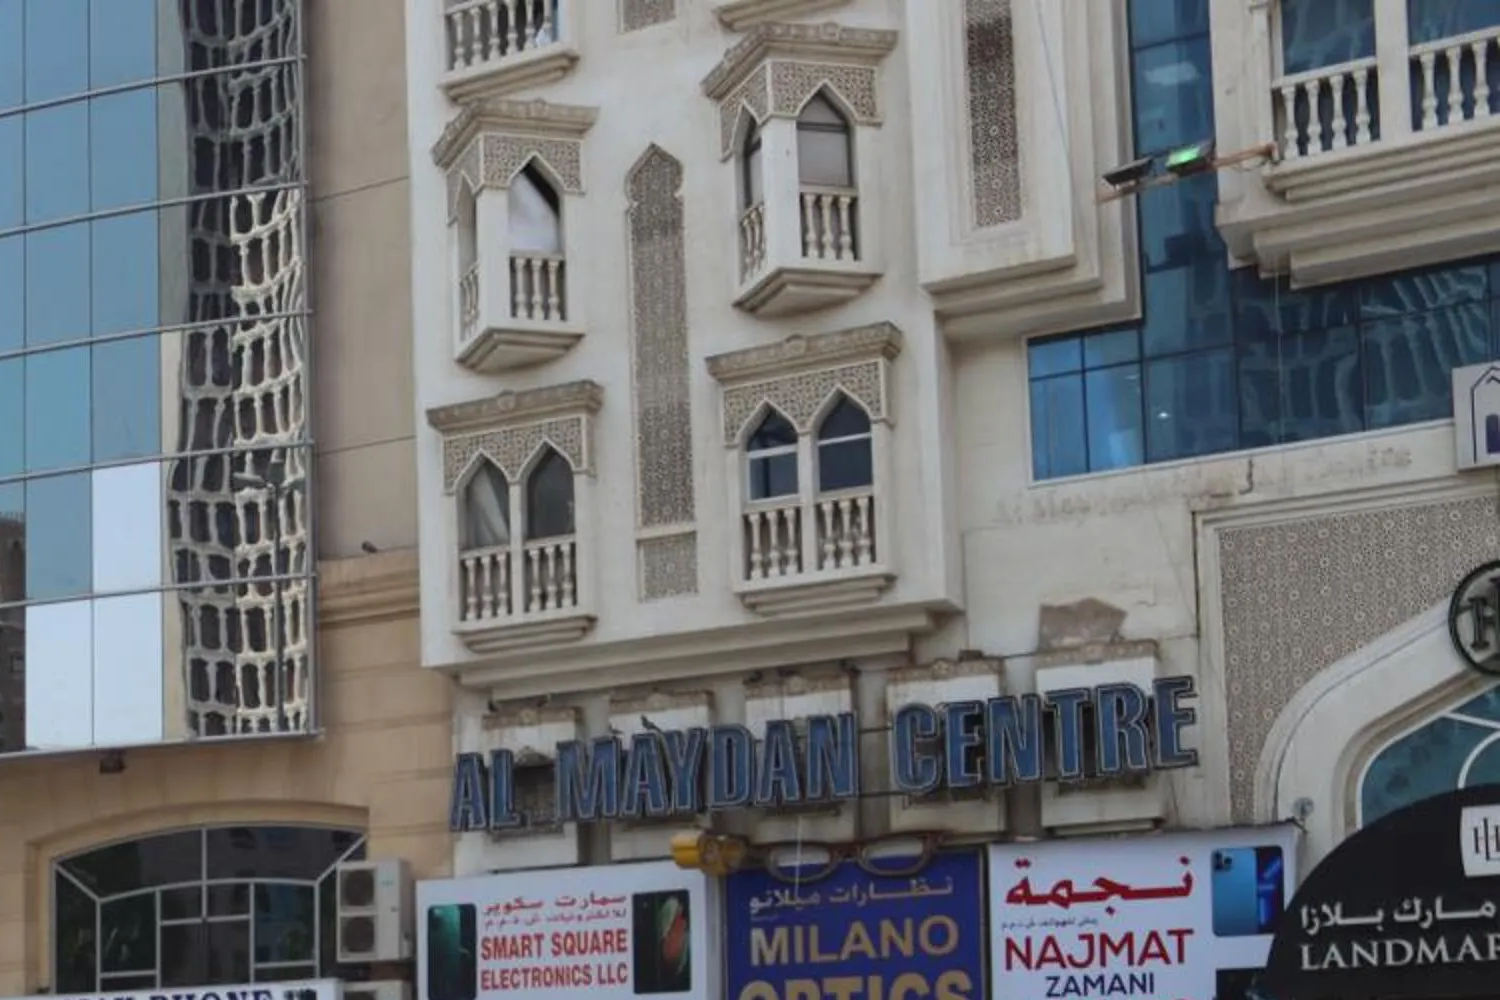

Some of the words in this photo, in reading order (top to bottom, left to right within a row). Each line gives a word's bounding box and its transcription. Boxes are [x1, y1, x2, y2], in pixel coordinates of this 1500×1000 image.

[449, 748, 517, 832] AL
[554, 710, 858, 825] MAYDAN
[893, 674, 1198, 793] CENTRE
[749, 887, 821, 915] ميلانو
[829, 875, 954, 907] نظارات
[1005, 856, 1194, 916] نجمة
[1300, 901, 1384, 936] بلازا
[1392, 896, 1497, 929] مارك
[481, 932, 545, 961] SMART
[550, 928, 628, 956] SQUARE
[751, 914, 959, 967] MILANO
[1004, 928, 1194, 971] NAJMAT
[481, 967, 592, 991] ELECTRONICS
[597, 963, 628, 984] LLC
[1045, 972, 1155, 998] ZAMANI
